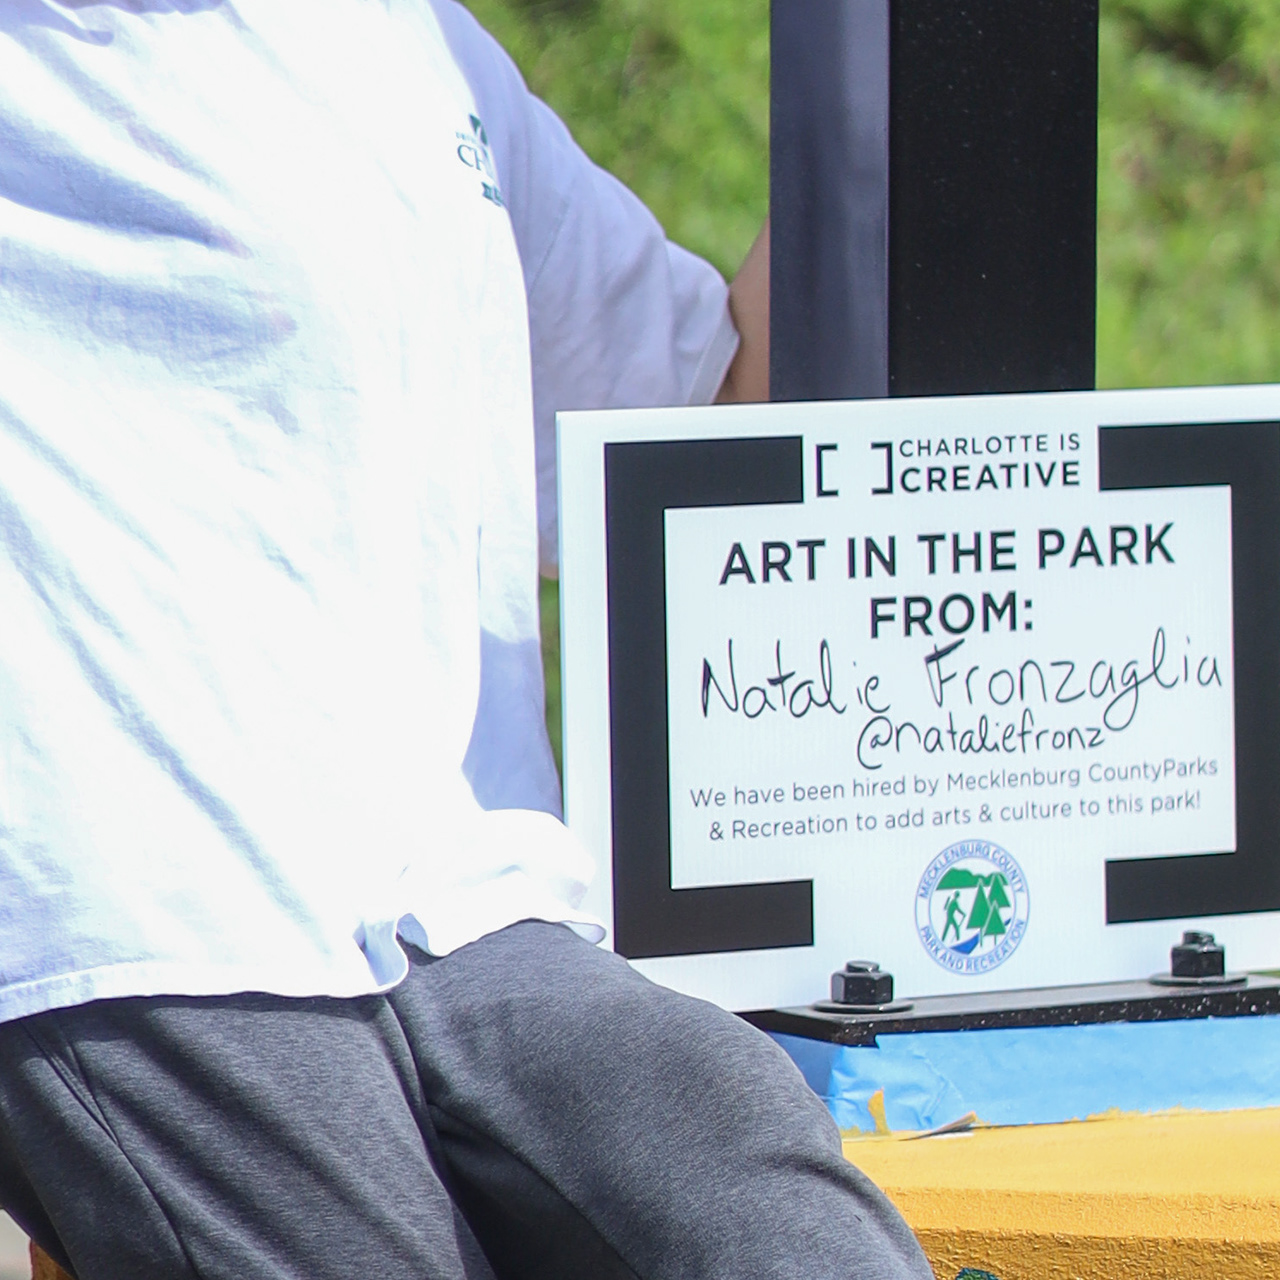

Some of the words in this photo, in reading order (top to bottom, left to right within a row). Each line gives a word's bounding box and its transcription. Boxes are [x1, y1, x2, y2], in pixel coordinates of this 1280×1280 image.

[899, 434, 1049, 458] CHARLOTTE
[1060, 433, 1081, 452] IS
[900, 461, 1080, 493] CREATIVE
[720, 538, 826, 586] ART
[848, 535, 897, 579] IN
[918, 529, 1017, 575] THE
[1038, 522, 1176, 569] PARK
[870, 590, 1034, 639] FROM:
[701, 637, 892, 719] Natalie
[923, 626, 1223, 732] Fronzaglia
[856, 707, 1106, 770] @nataliefronz
[690, 788, 726, 808] We
[734, 786, 785, 805] have
[793, 782, 845, 802] been
[852, 776, 906, 797] hired
[914, 774, 940, 797] by
[947, 766, 1081, 792] Mecklenburg
[709, 820, 724, 841] &
[732, 814, 849, 839] Recreation
[856, 812, 878, 832] to
[885, 807, 925, 830] add
[932, 806, 971, 827] arts
[978, 803, 993, 822] &
[1000, 800, 1072, 821] culture
[1079, 797, 1100, 816] to
[1108, 793, 1144, 815] this
[1151, 788, 1201, 815] park!
[918, 843, 990, 900] MECKLENBURG
[991, 849, 1025, 894] COUNTY
[920, 924, 941, 957] PARK
[939, 951, 964, 971] AND
[964, 918, 1025, 972] RECREATION
